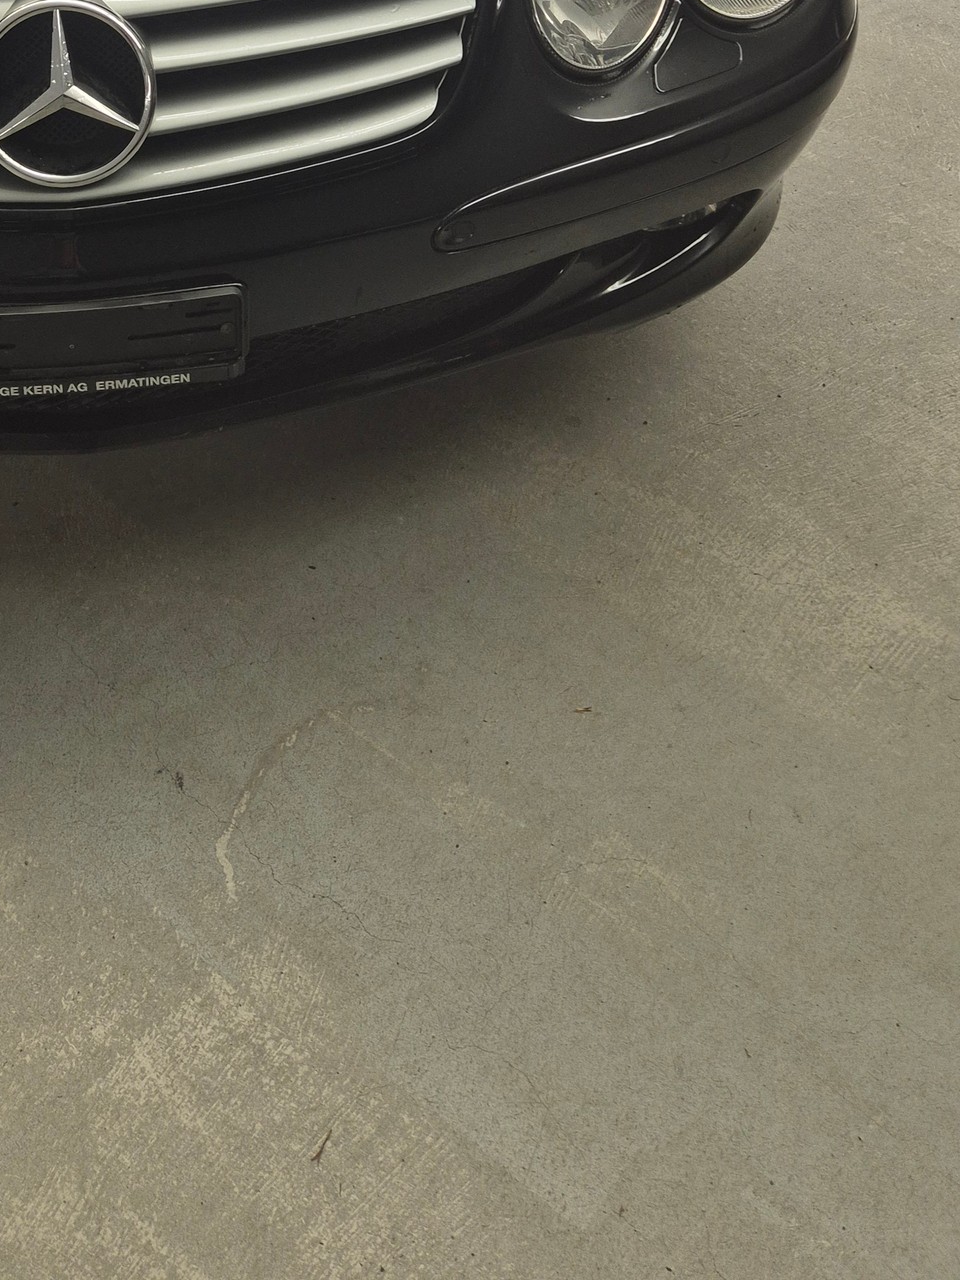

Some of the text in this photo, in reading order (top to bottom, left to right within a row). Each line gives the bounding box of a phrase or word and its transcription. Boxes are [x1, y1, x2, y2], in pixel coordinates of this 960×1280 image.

[23, 384, 64, 396] KERN
[66, 382, 88, 393] AG
[95, 373, 191, 391] ERMATINGEN
